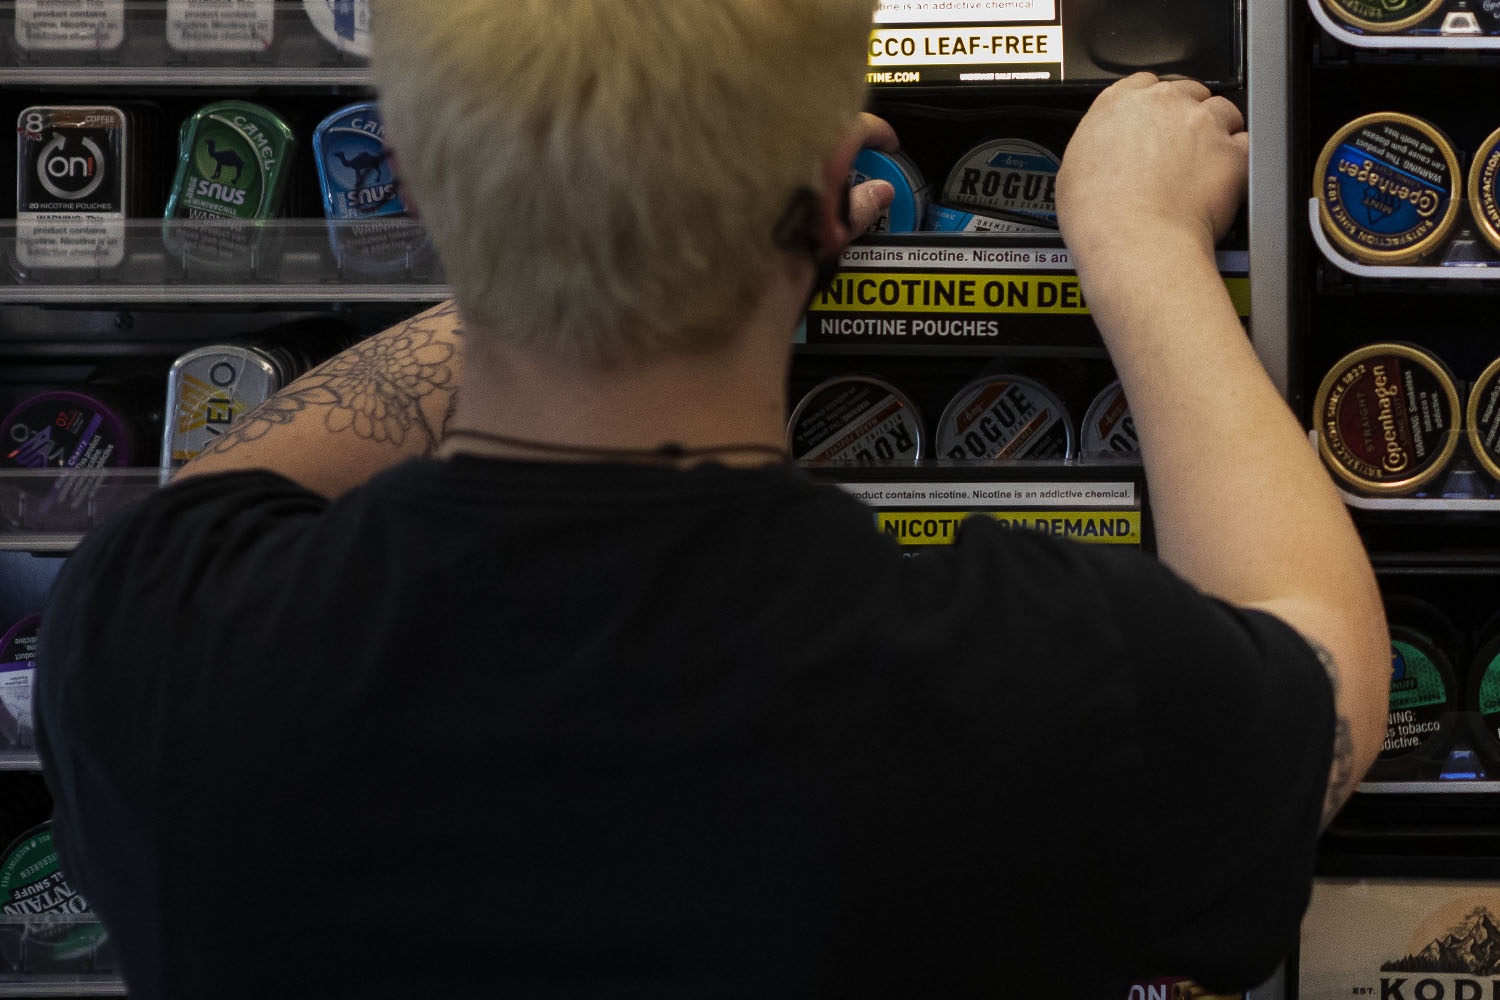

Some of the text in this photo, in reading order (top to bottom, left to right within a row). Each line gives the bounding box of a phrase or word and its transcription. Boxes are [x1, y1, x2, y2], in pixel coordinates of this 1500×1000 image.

[925, 35, 1048, 56] LEAF-FREE
[233, 115, 276, 171] CAMEL
[48, 157, 93, 177] on!
[822, 278, 1029, 307] NICOTINE ON
[821, 319, 998, 337] NICOTINE POUCHES
[1352, 987, 1376, 996] EST.
